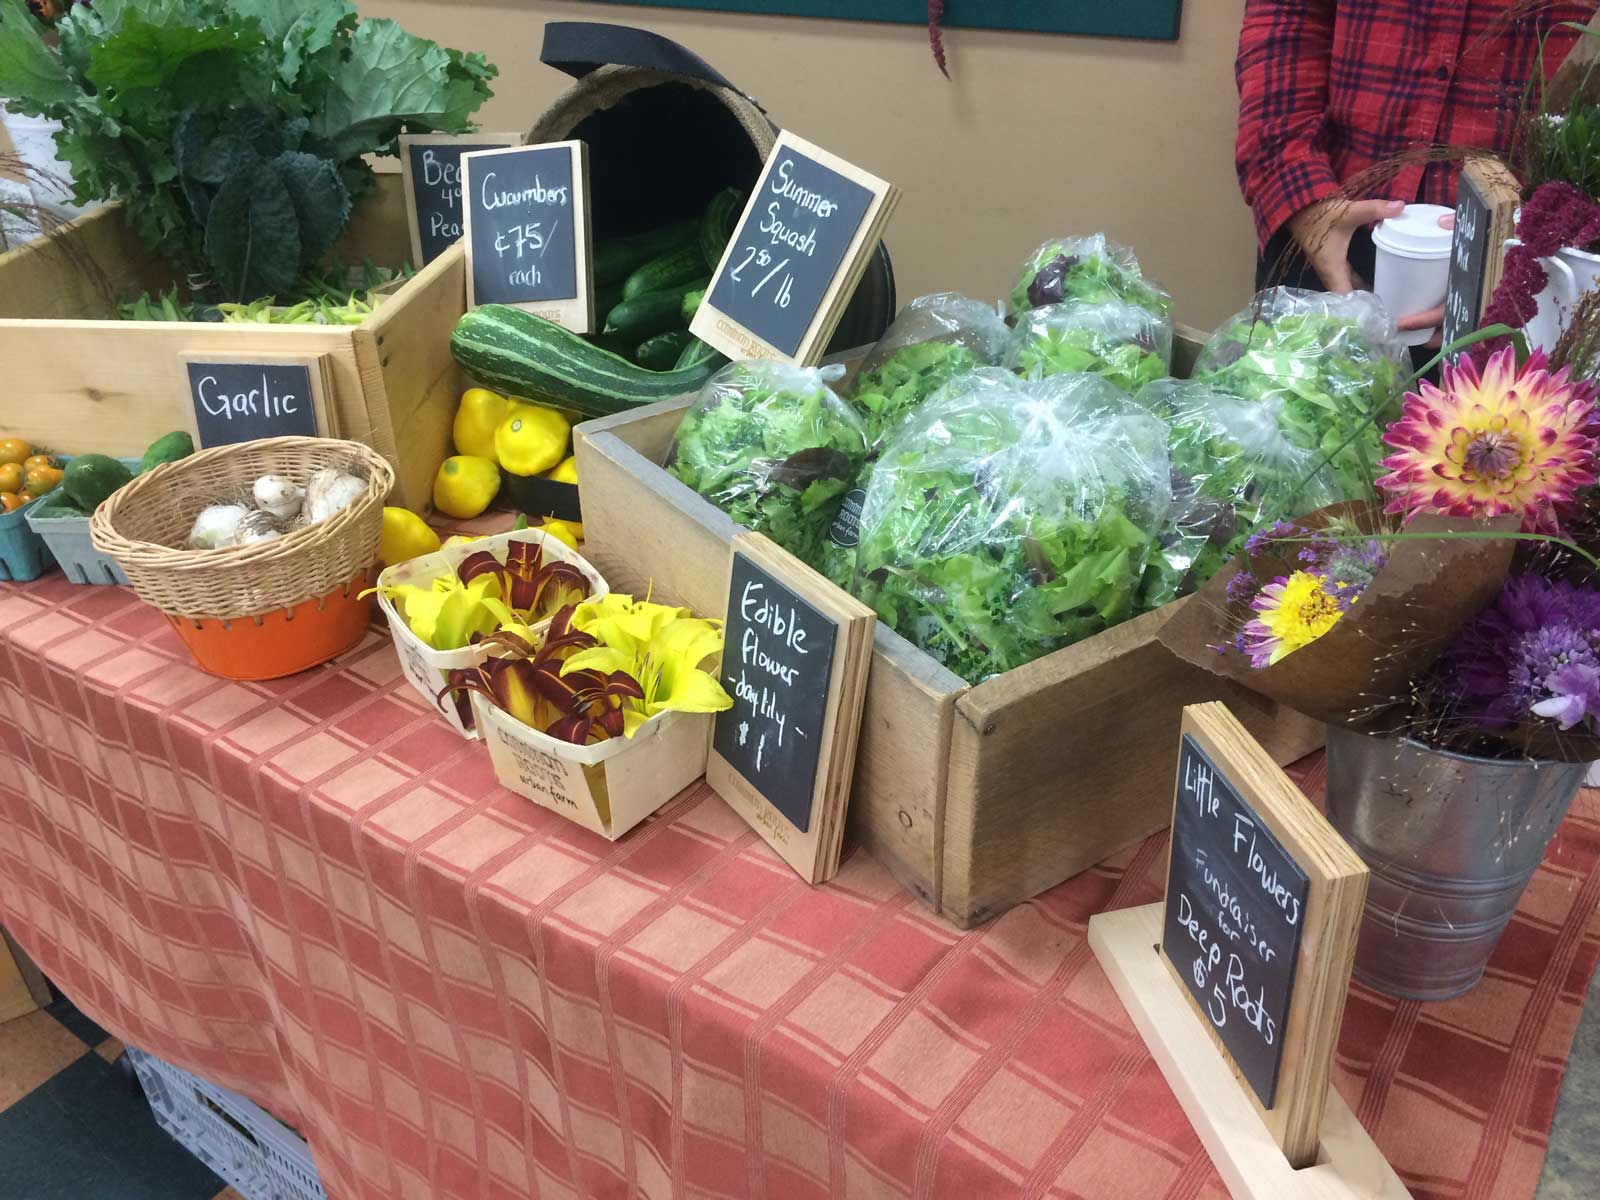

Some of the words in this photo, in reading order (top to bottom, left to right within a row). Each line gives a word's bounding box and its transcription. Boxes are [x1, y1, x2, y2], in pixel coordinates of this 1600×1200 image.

[481, 172, 568, 211] Cucumbers
[771, 159, 838, 218] Summer
[431, 211, 464, 237] Pea
[759, 201, 817, 257] Squash
[1455, 196, 1477, 247] Salad
[508, 264, 542, 287] each
[197, 372, 298, 420] Garlic
[740, 580, 809, 654] Edible
[1184, 754, 1220, 818] Little
[1233, 811, 1301, 926] Flowers
[1194, 847, 1276, 963] Fundraiser
[1216, 910, 1242, 951] for
[1177, 892, 1221, 973] Deep
[1225, 953, 1275, 1046] Roots
